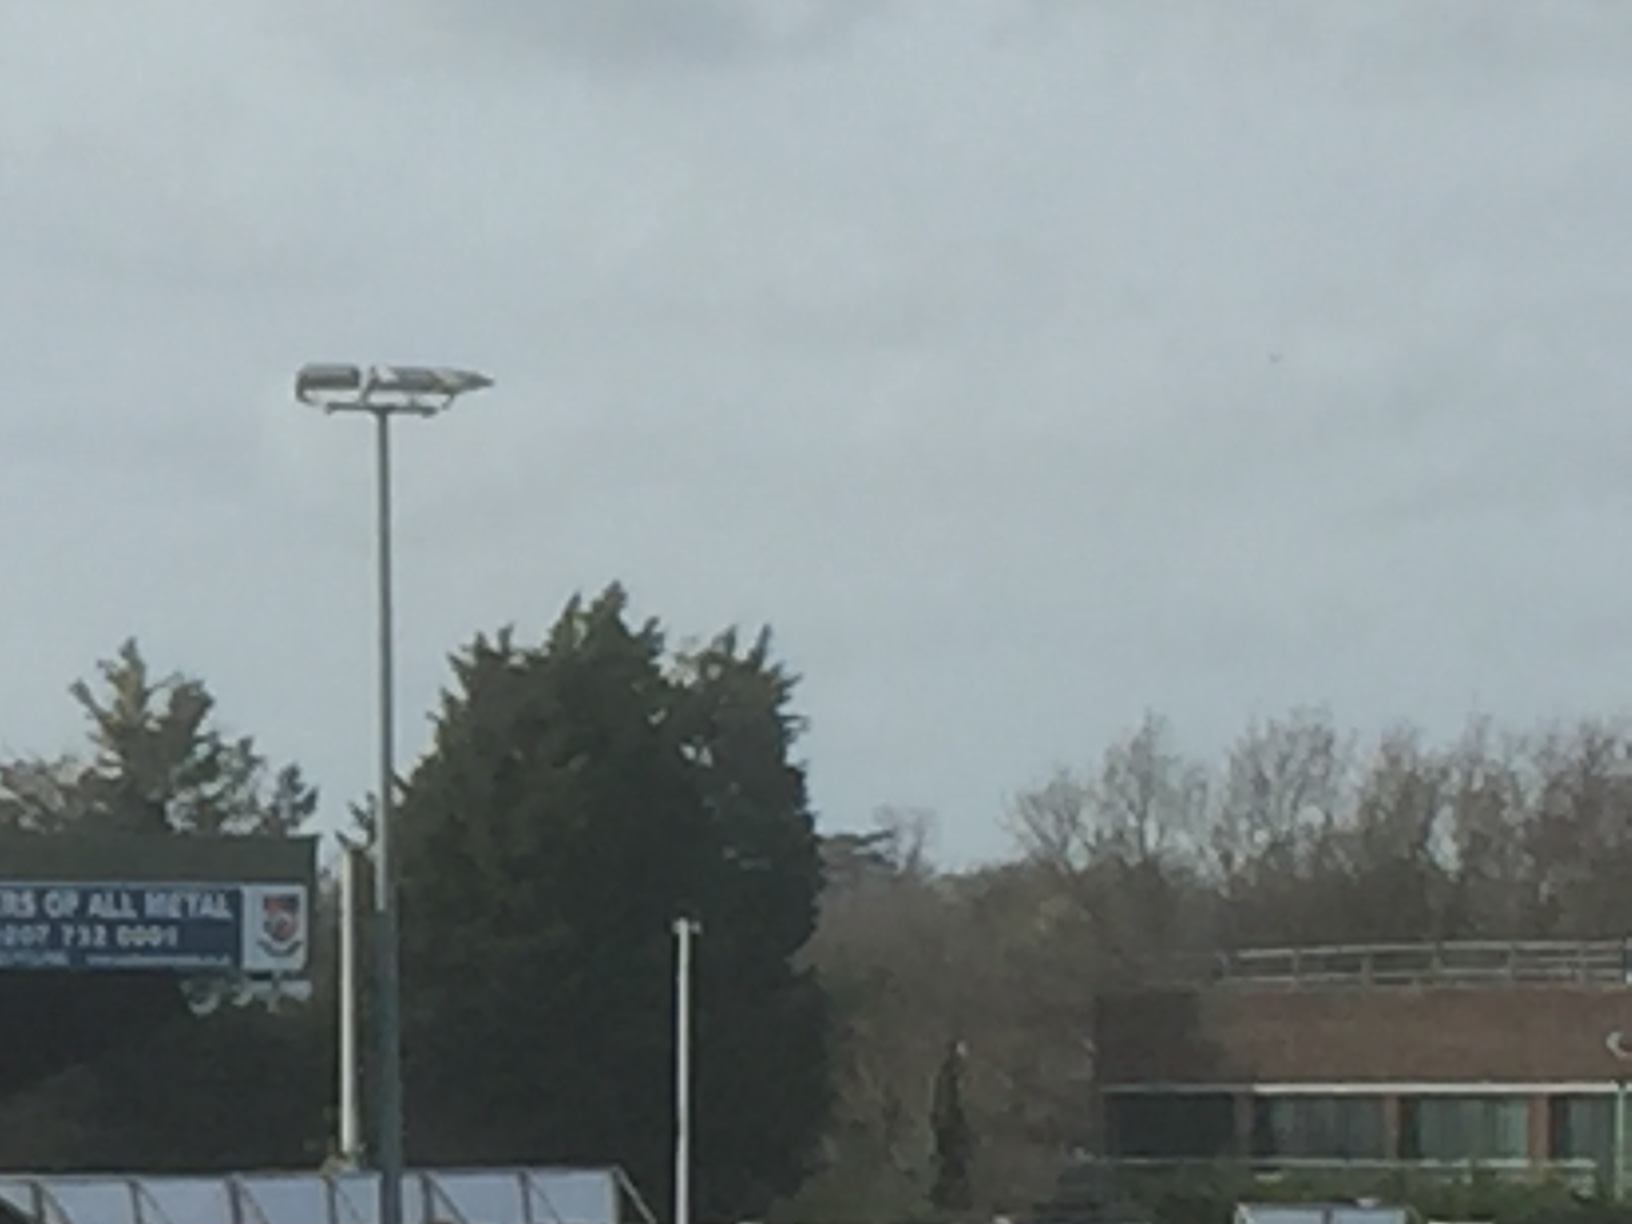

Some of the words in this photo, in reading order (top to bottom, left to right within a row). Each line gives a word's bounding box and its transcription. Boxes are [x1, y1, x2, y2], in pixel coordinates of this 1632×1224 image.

[43, 889, 80, 918] OF
[87, 890, 138, 919] ALL
[144, 890, 234, 919] METAL
